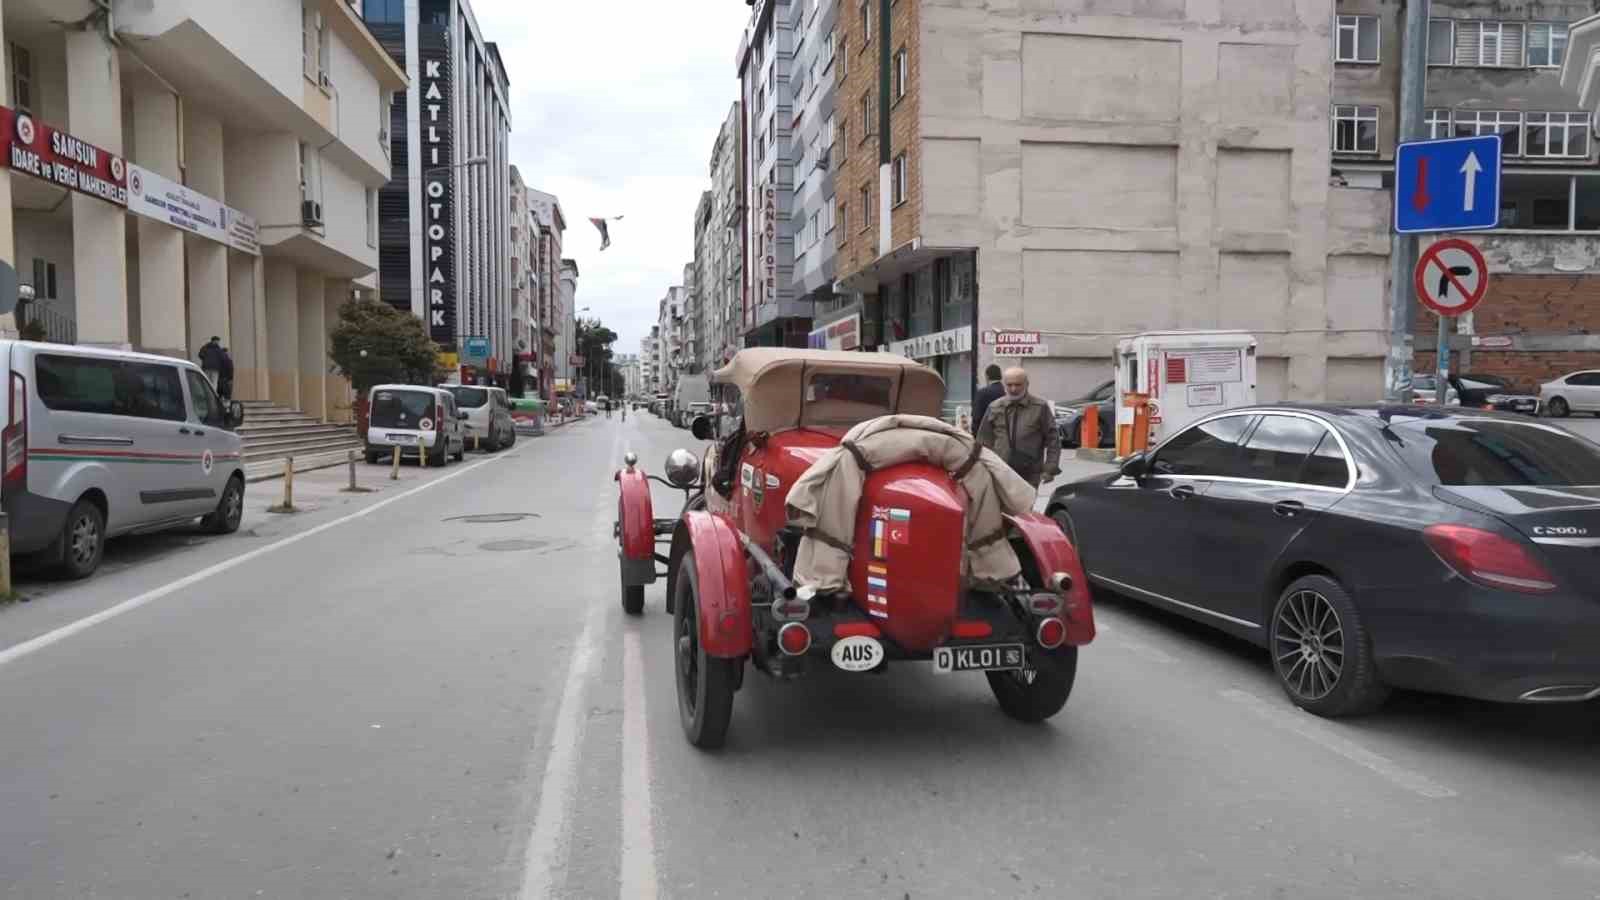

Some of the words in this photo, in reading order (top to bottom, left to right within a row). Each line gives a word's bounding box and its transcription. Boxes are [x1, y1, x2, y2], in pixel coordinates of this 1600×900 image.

[425, 60, 442, 165] KATLI
[11, 142, 40, 175] İDARE
[41, 161, 52, 178] ve
[52, 162, 78, 187] VERGİ
[79, 171, 128, 205] MAHKEMELER
[53, 132, 97, 168] SAMSUN
[427, 181, 445, 326] OTOPARK
[766, 255, 775, 298] OTEL
[842, 644, 873, 662] AUS
